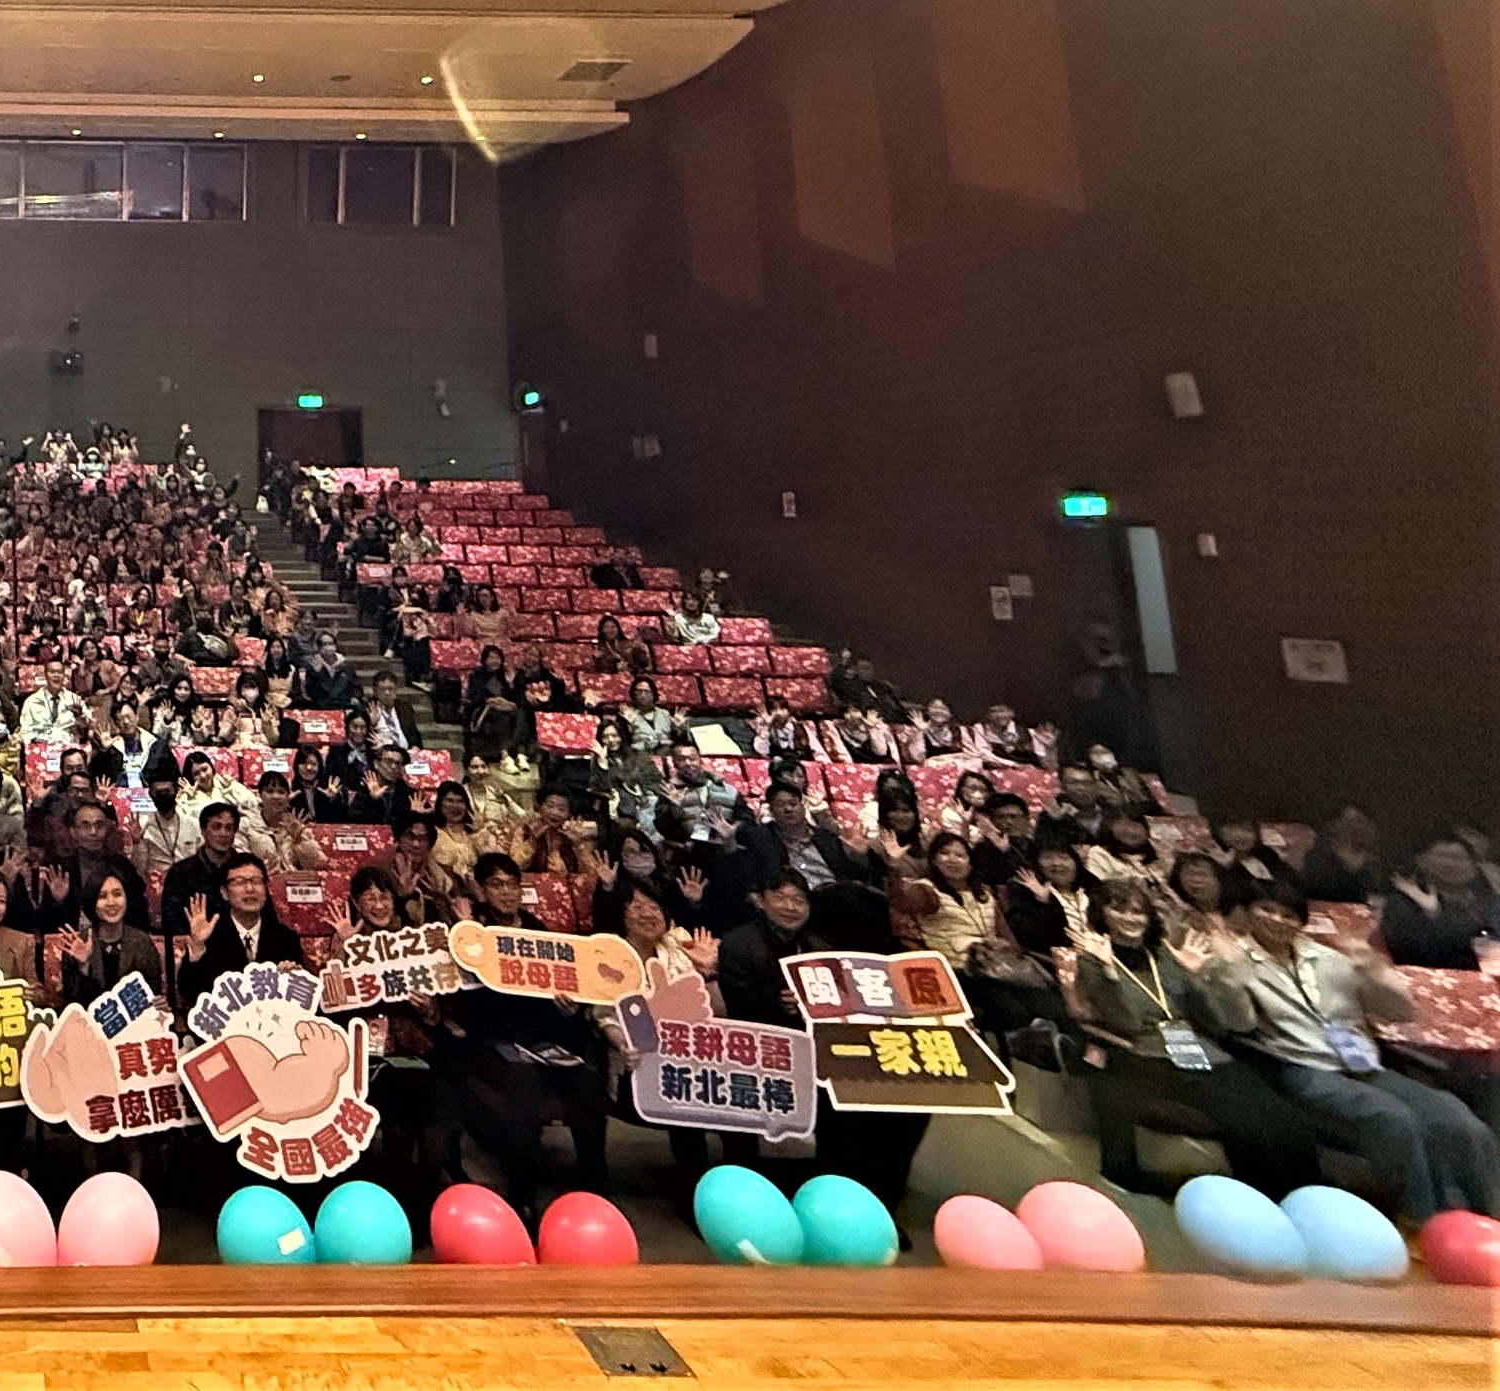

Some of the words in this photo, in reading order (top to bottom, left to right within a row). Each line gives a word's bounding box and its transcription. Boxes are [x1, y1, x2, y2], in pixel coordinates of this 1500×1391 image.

[348, 926, 449, 966] 文化之美
[497, 936, 575, 963] 現在開始
[357, 961, 460, 1002] 多族共存
[500, 958, 580, 993] 說母語
[193, 968, 318, 1040] 新北教育
[659, 1021, 793, 1072] 深耕母語
[832, 1029, 969, 1077] 一家親
[661, 1064, 795, 1115] 新北最棒
[243, 1097, 374, 1176] 全國最強
